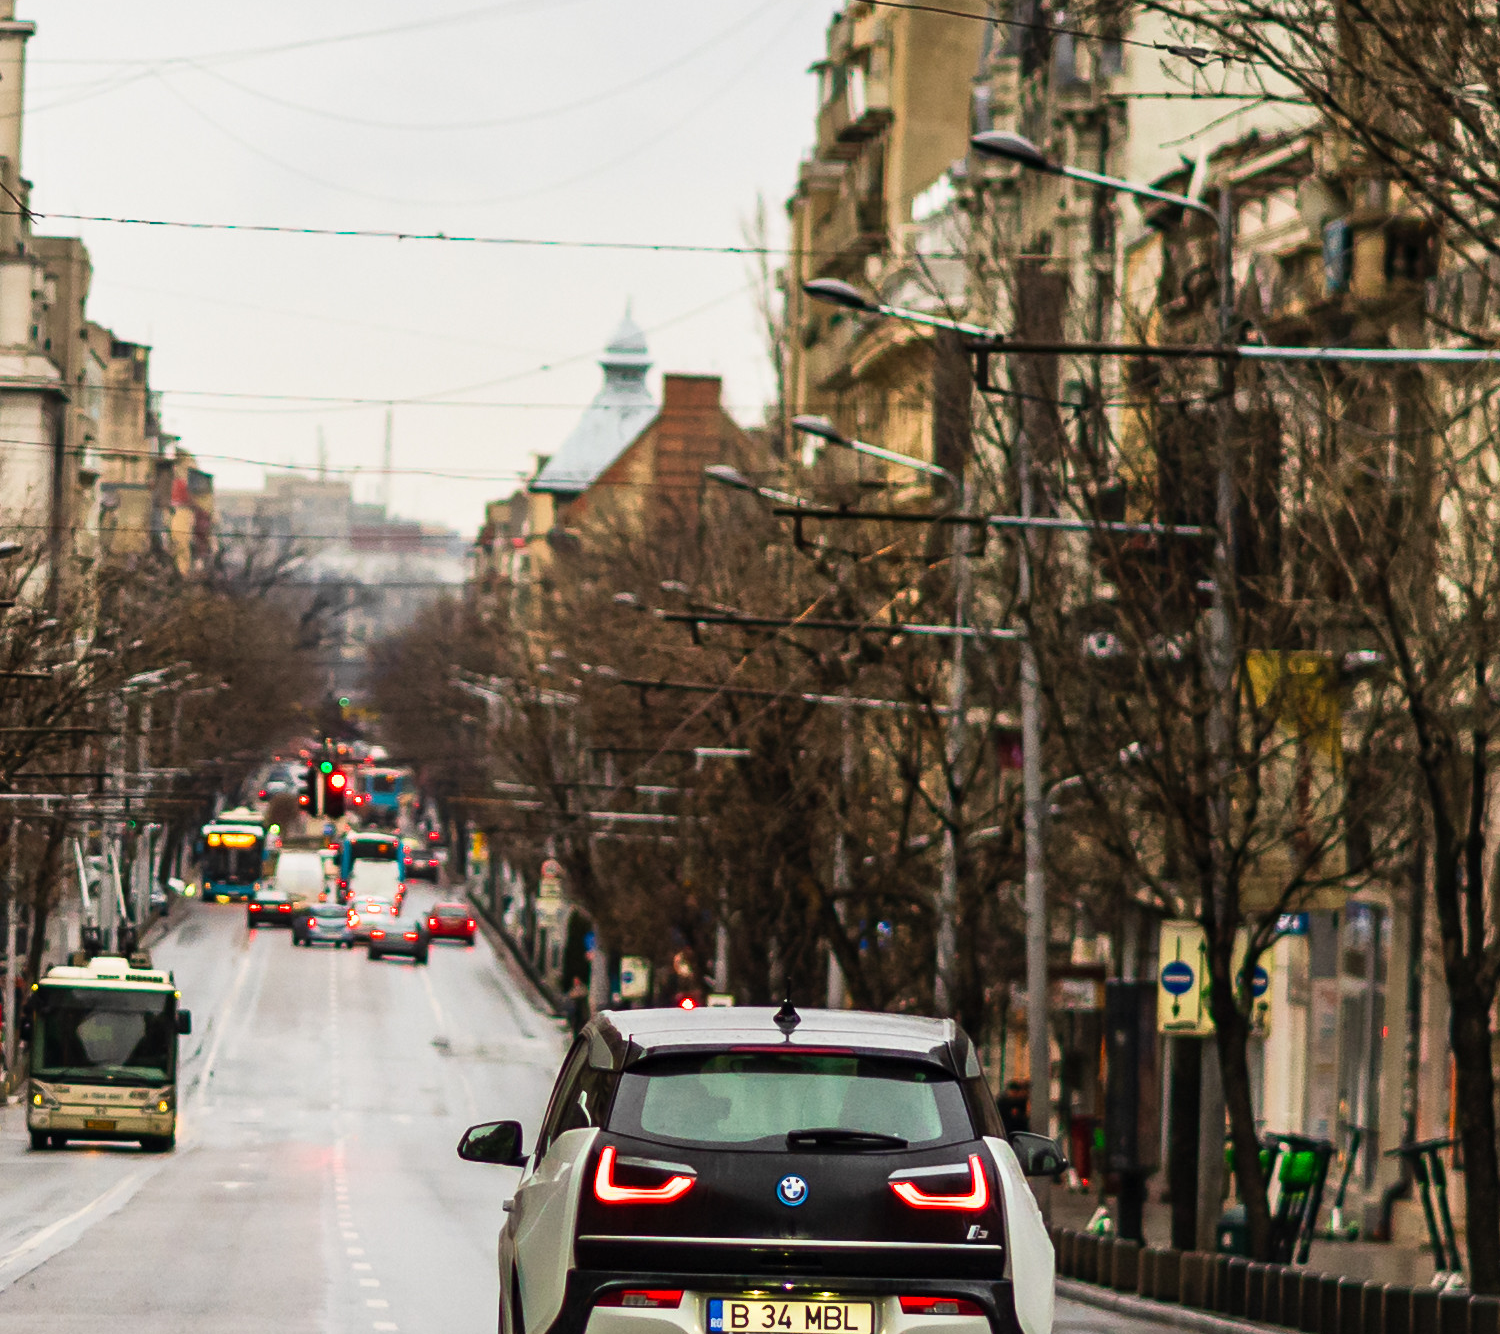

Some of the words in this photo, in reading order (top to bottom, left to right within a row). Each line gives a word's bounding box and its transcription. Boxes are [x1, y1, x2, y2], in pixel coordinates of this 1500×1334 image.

[731, 1304, 749, 1329] B
[761, 1304, 792, 1329] 34
[805, 1305, 858, 1331] MBL
